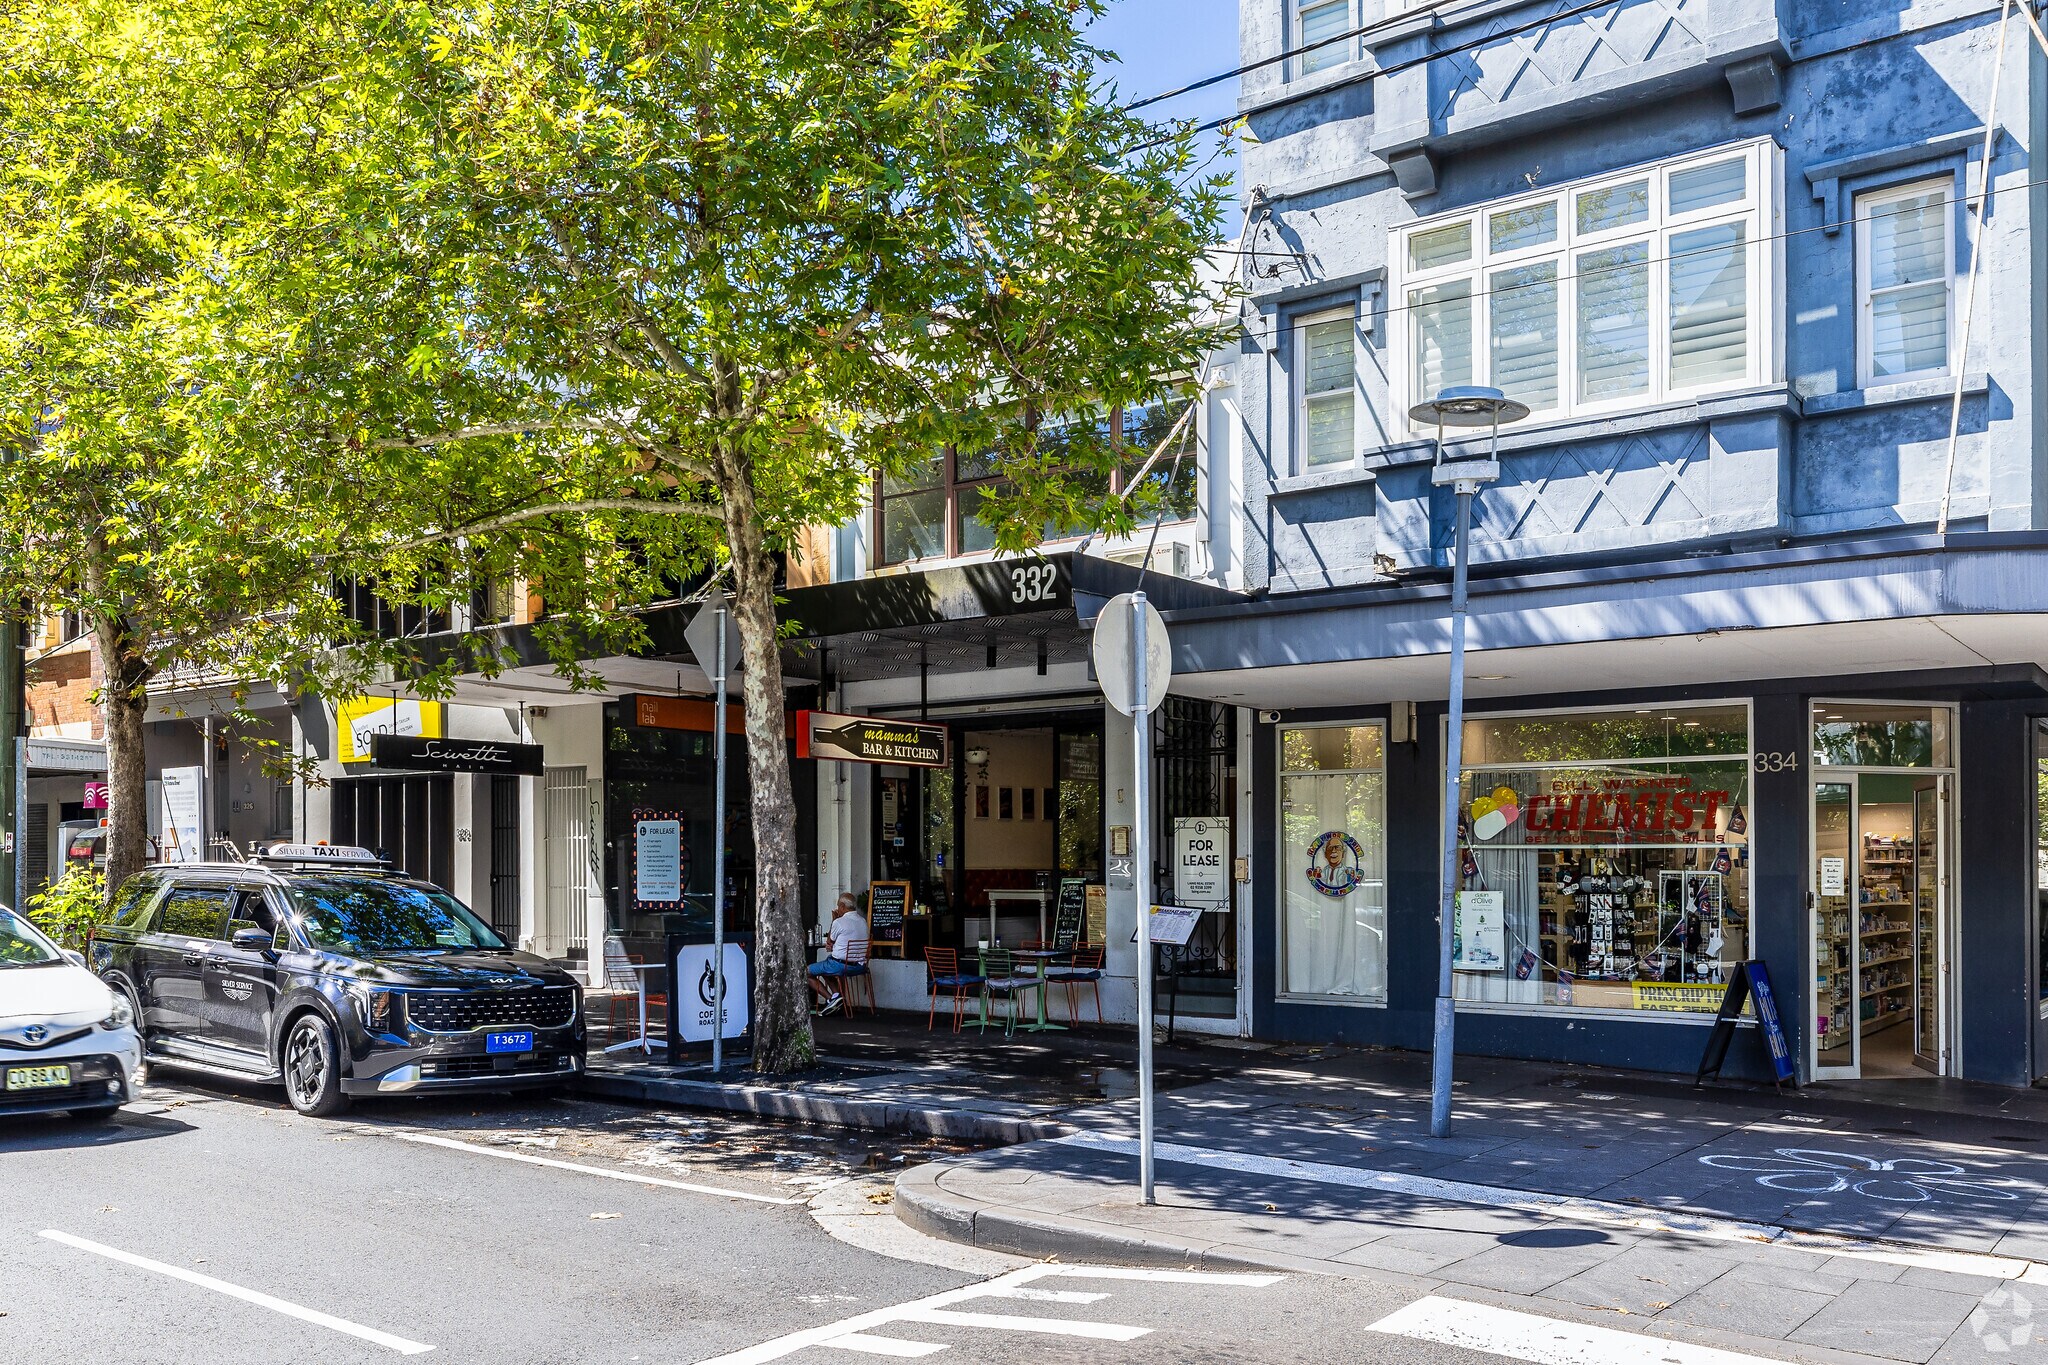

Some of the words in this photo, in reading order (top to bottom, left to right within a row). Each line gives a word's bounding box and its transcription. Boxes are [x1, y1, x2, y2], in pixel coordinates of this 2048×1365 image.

[1012, 564, 1056, 603] 332
[642, 701, 658, 712] nail
[642, 712, 656, 724] lab
[864, 727, 919, 743] mamma's
[411, 741, 512, 763] Scivetti
[862, 742, 883, 755] BAR
[885, 744, 893, 756] &
[894, 745, 939, 760] KITCHEN
[1754, 751, 1798, 773] 334
[1552, 780, 1593, 791] BILL
[1603, 777, 1691, 790] WARNER
[1526, 790, 1729, 831] CHEMIST
[1526, 835, 1550, 843] GET
[1557, 835, 1589, 843] YOUR
[1189, 840, 1213, 851] FOR
[279, 847, 305, 856] SILVER
[312, 847, 340, 857] TAXI
[342, 851, 373, 859] SERVICE
[1183, 855, 1219, 866] LEASE
[221, 979, 235, 988] SILVER
[236, 981, 254, 990] SERVICE
[1639, 986, 1726, 1003] PRESCRIPTIO
[698, 1009, 728, 1019] COFE
[698, 1018, 728, 1026] ROASRS
[494, 1036, 500, 1044] T
[502, 1034, 526, 1045] 3672
